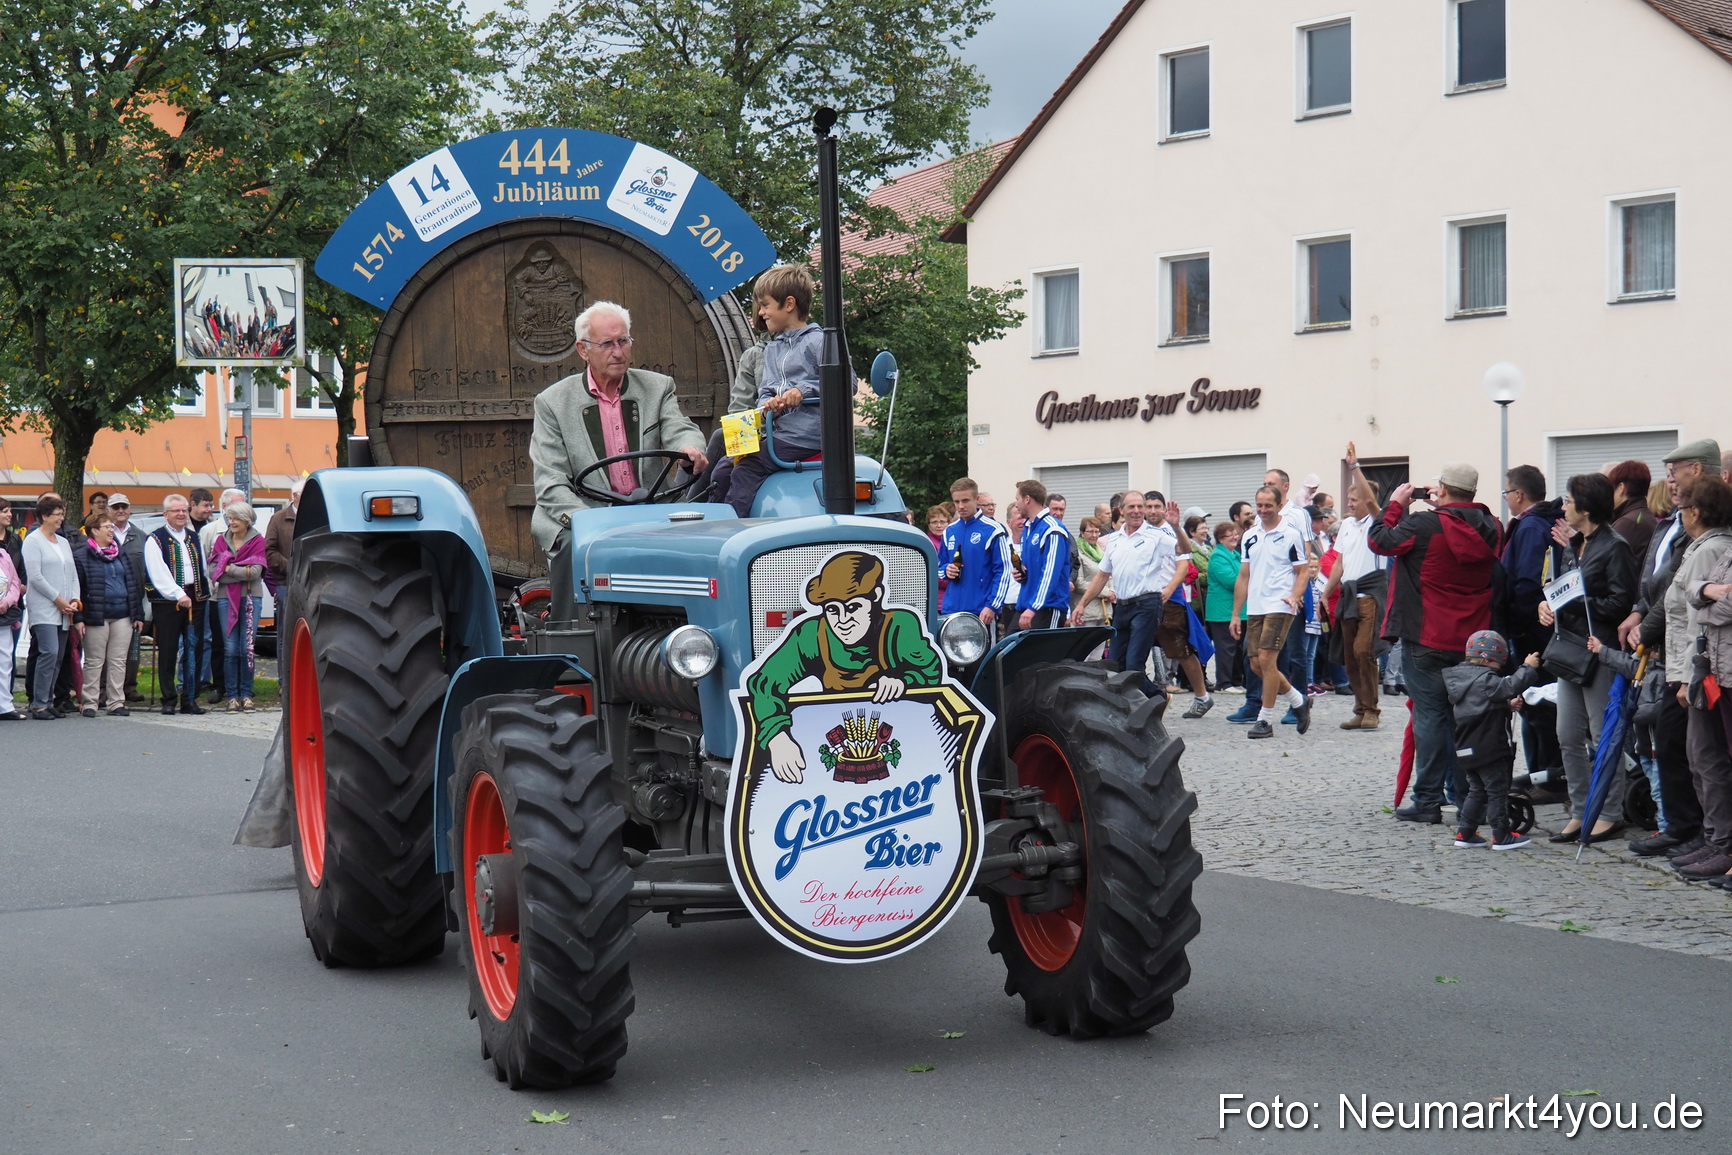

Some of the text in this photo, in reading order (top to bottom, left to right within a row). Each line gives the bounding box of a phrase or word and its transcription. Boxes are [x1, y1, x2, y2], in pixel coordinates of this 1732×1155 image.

[499, 138, 604, 179] 444 Jahre
[407, 163, 450, 208] 14
[493, 181, 601, 203] Jubiläum
[625, 179, 677, 198] Glossner
[414, 188, 472, 225] Generationen
[419, 198, 479, 236] Brautradition
[644, 197, 667, 214] Bräu
[352, 221, 405, 283] 1574
[686, 214, 744, 273] 2018
[1035, 377, 1262, 429] Gasthaus zur Sonne
[434, 428, 497, 456] Franz
[1550, 582, 1570, 600] swn
[774, 774, 942, 882] Glossner
[863, 828, 943, 872] Bier
[800, 875, 924, 906] Der hochfeine
[812, 903, 915, 933] Biergenuss
